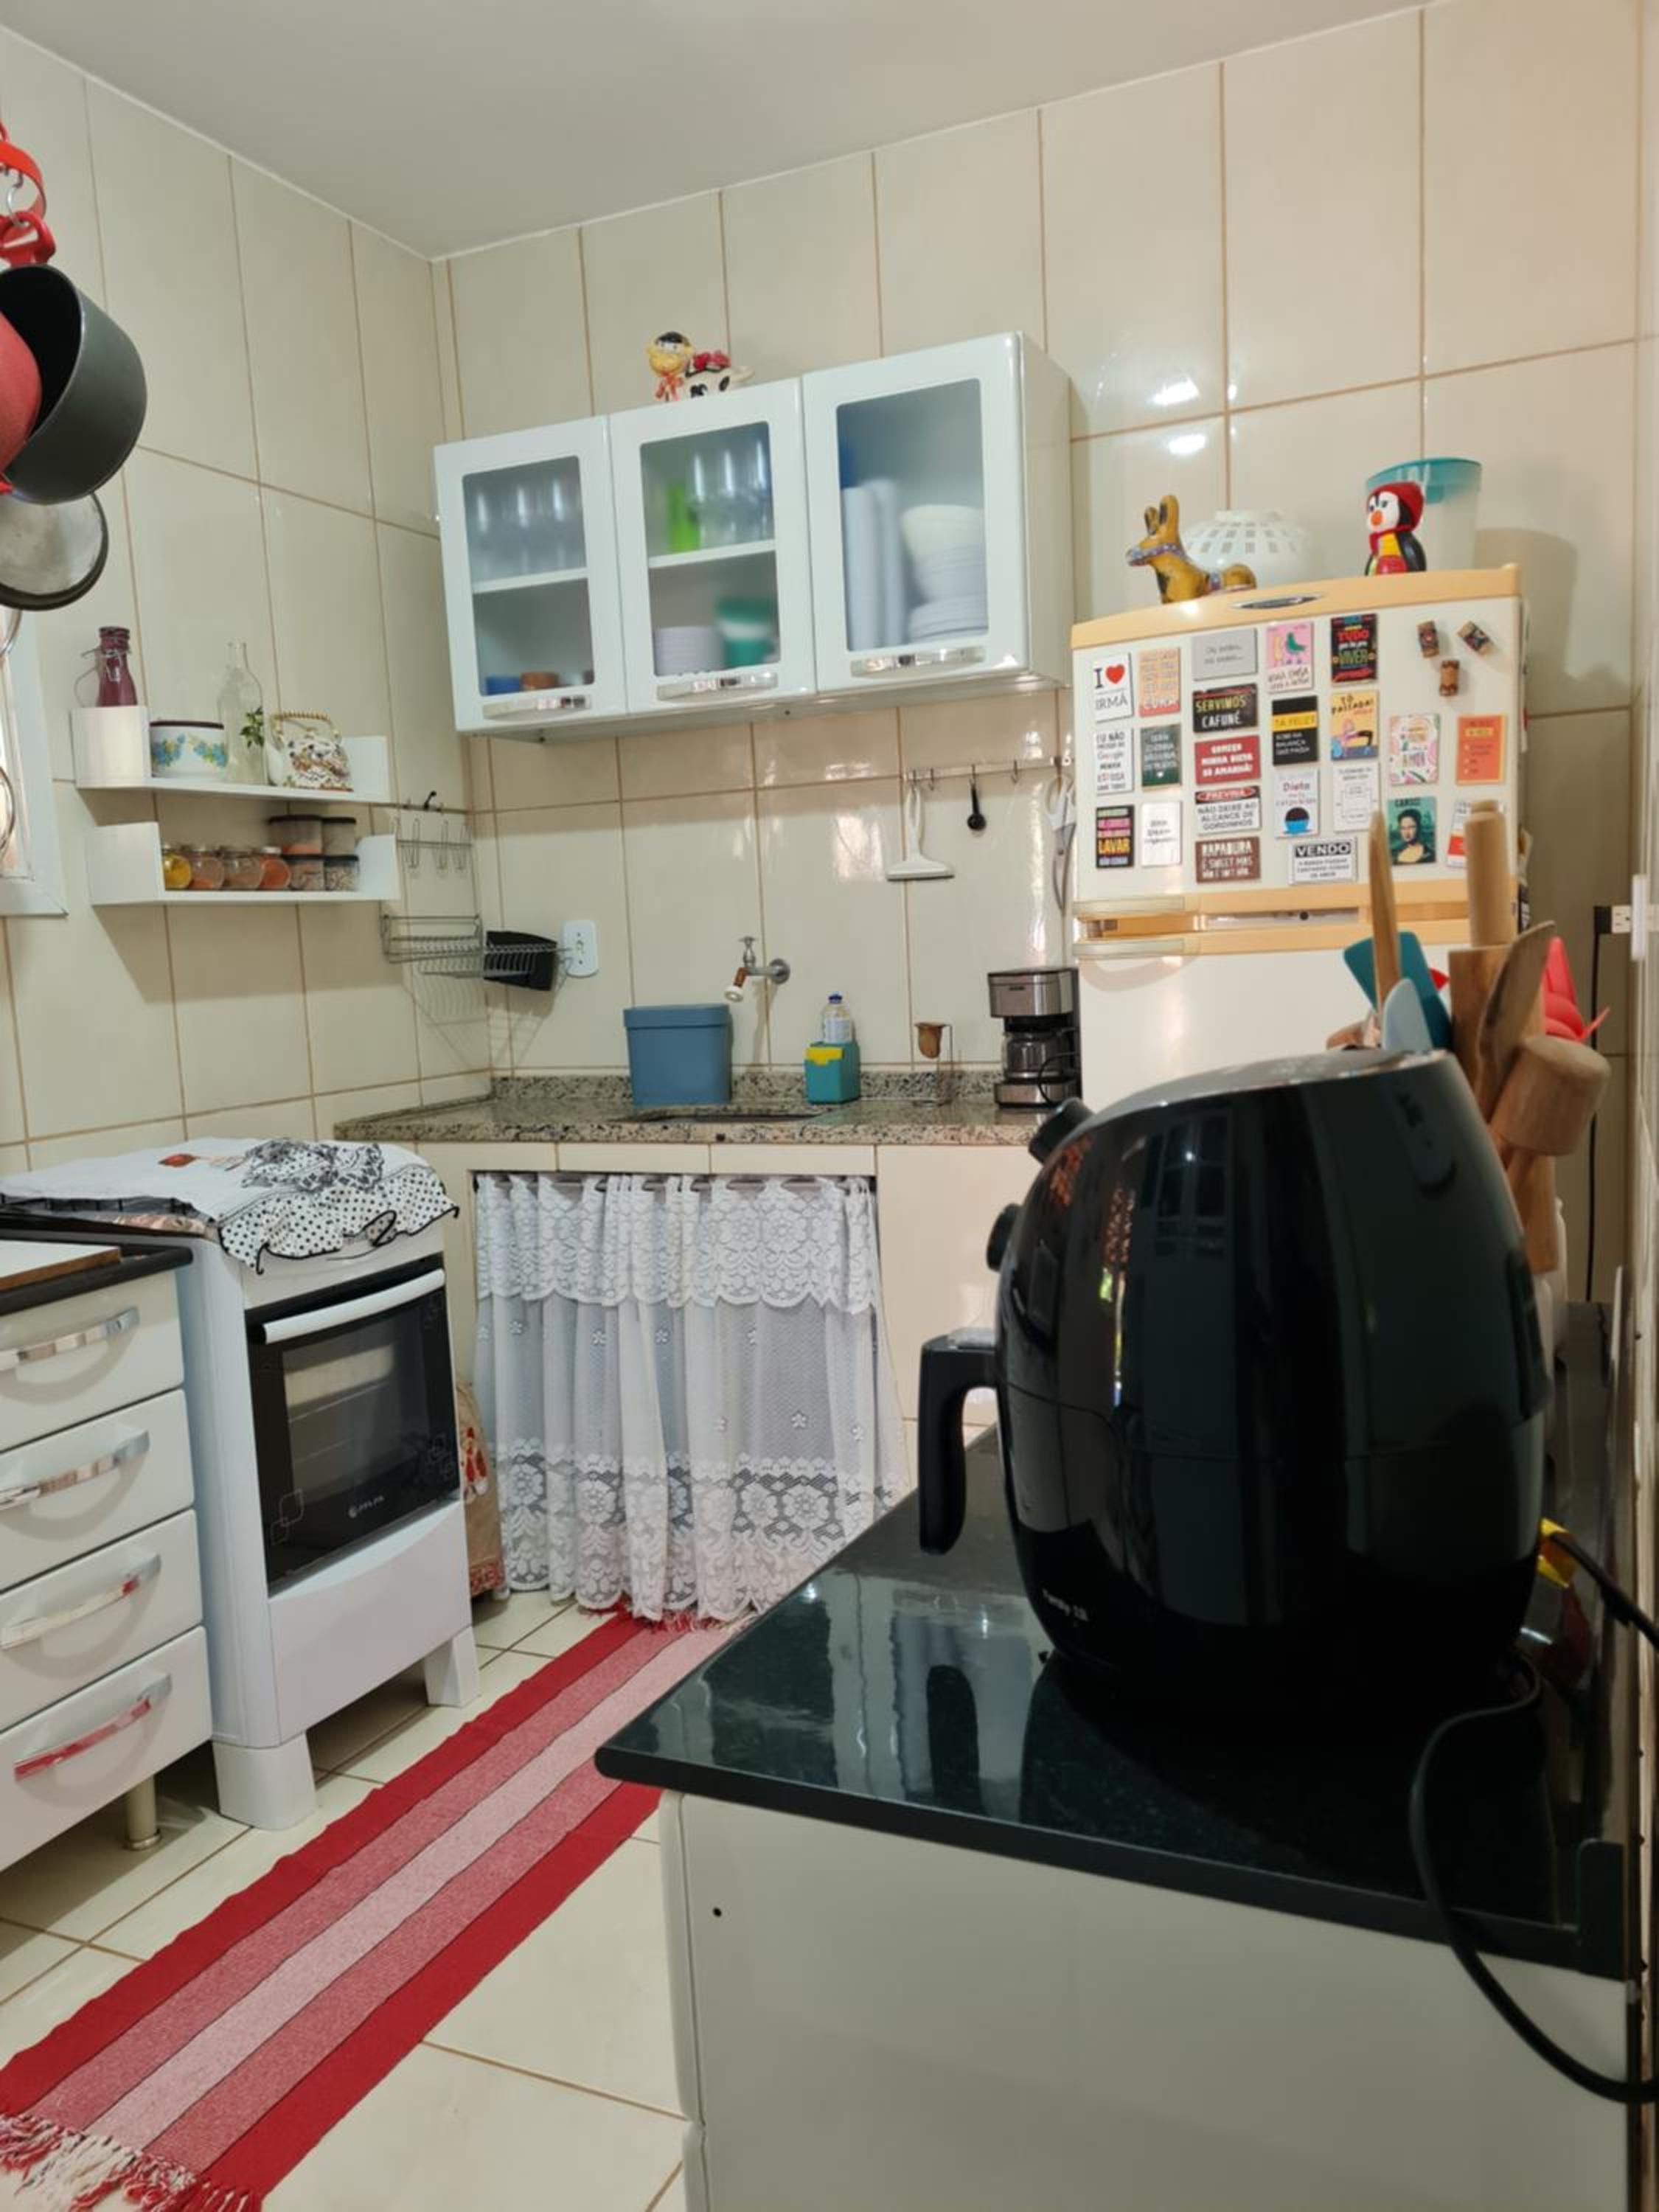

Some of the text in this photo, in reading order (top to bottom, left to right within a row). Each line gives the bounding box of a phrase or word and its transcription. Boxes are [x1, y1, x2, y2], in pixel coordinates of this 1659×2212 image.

[1338, 630, 1369, 642] TUDO
[1093, 667, 1104, 689] I
[1195, 695, 1247, 713] SERVIMOS
[1202, 710, 1241, 728] CAFUNÉ
[1097, 837, 1130, 855] LAVAR
[1202, 839, 1253, 856] RAPADURA
[1297, 843, 1349, 857] VENDO
